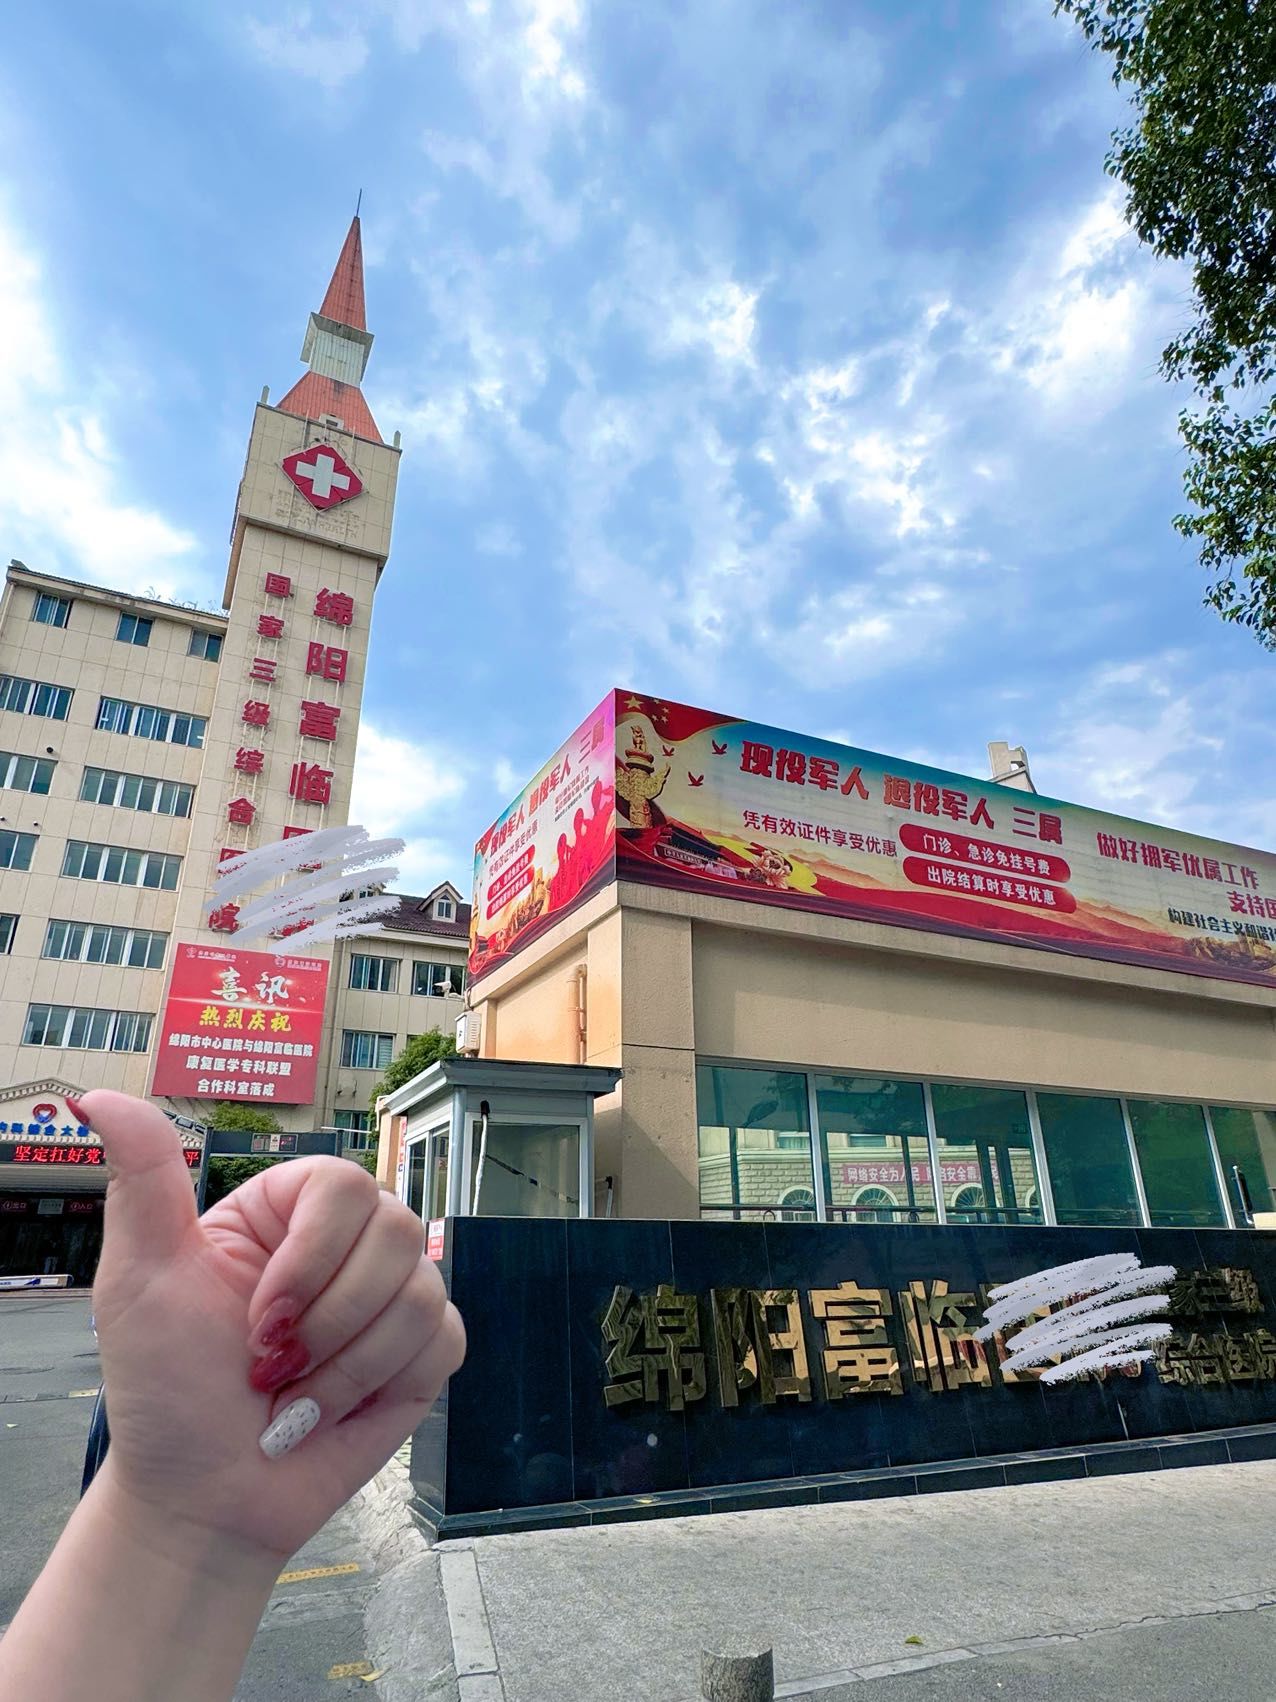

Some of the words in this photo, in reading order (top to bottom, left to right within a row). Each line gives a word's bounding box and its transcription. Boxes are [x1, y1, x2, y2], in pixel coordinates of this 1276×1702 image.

[267, 587, 354, 938] 绵阳富临
[740, 740, 870, 801] 现役军人
[883, 773, 995, 830] 退役军人
[1012, 806, 1063, 845] 三属
[743, 810, 898, 858] 凭有效证件享受优惠
[923, 833, 1051, 876] 门诊、急诊免挂号费
[1096, 831, 1260, 890] 做好拥军优属工作
[927, 867, 1057, 906] 出院结算时享受优惠
[211, 966, 290, 1003] 喜讯
[199, 1005, 292, 1032] 热烈庆祝
[168, 1033, 313, 1057] 绵阳市中心医院与绵阳富临医院
[186, 1056, 292, 1077] 康复医学专科联盟
[197, 1079, 275, 1097] 合作科室落成
[13, 1145, 106, 1164] 坚定扛好党
[600, 1279, 1142, 1412] 绵阳富临
